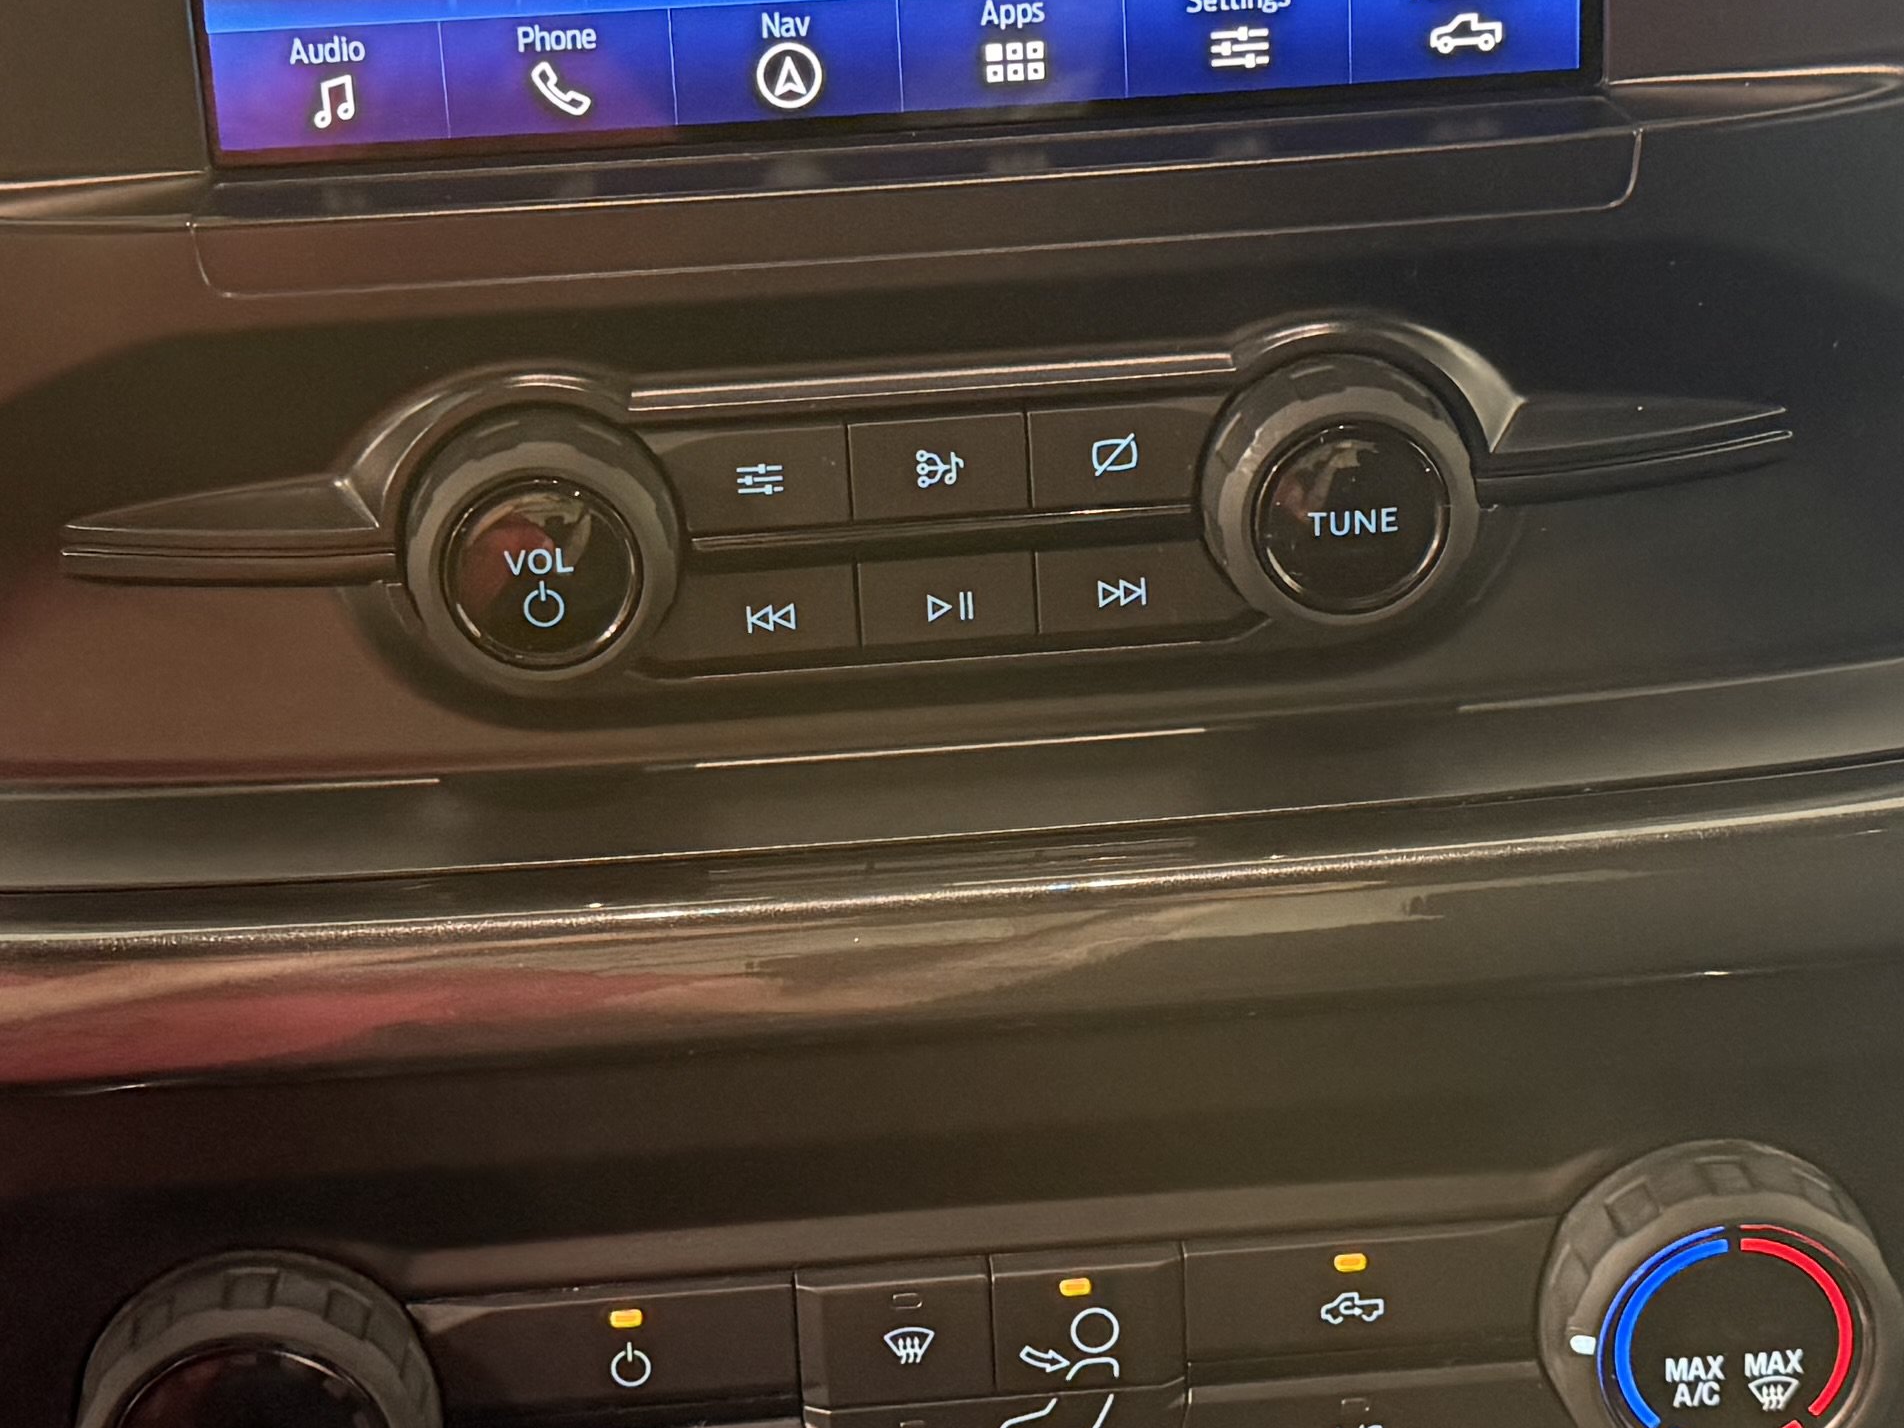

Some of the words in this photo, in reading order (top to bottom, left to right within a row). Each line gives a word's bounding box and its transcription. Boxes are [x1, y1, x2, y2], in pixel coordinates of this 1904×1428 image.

[517, 24, 597, 53] Phone
[761, 11, 811, 40] Nav
[289, 35, 366, 66] Audio
[1307, 506, 1400, 539] TUNE
[503, 549, 574, 577] VOL
[1664, 1355, 1726, 1383] MAX
[1744, 1348, 1804, 1376] MAX
[1673, 1381, 1721, 1408] A/C
